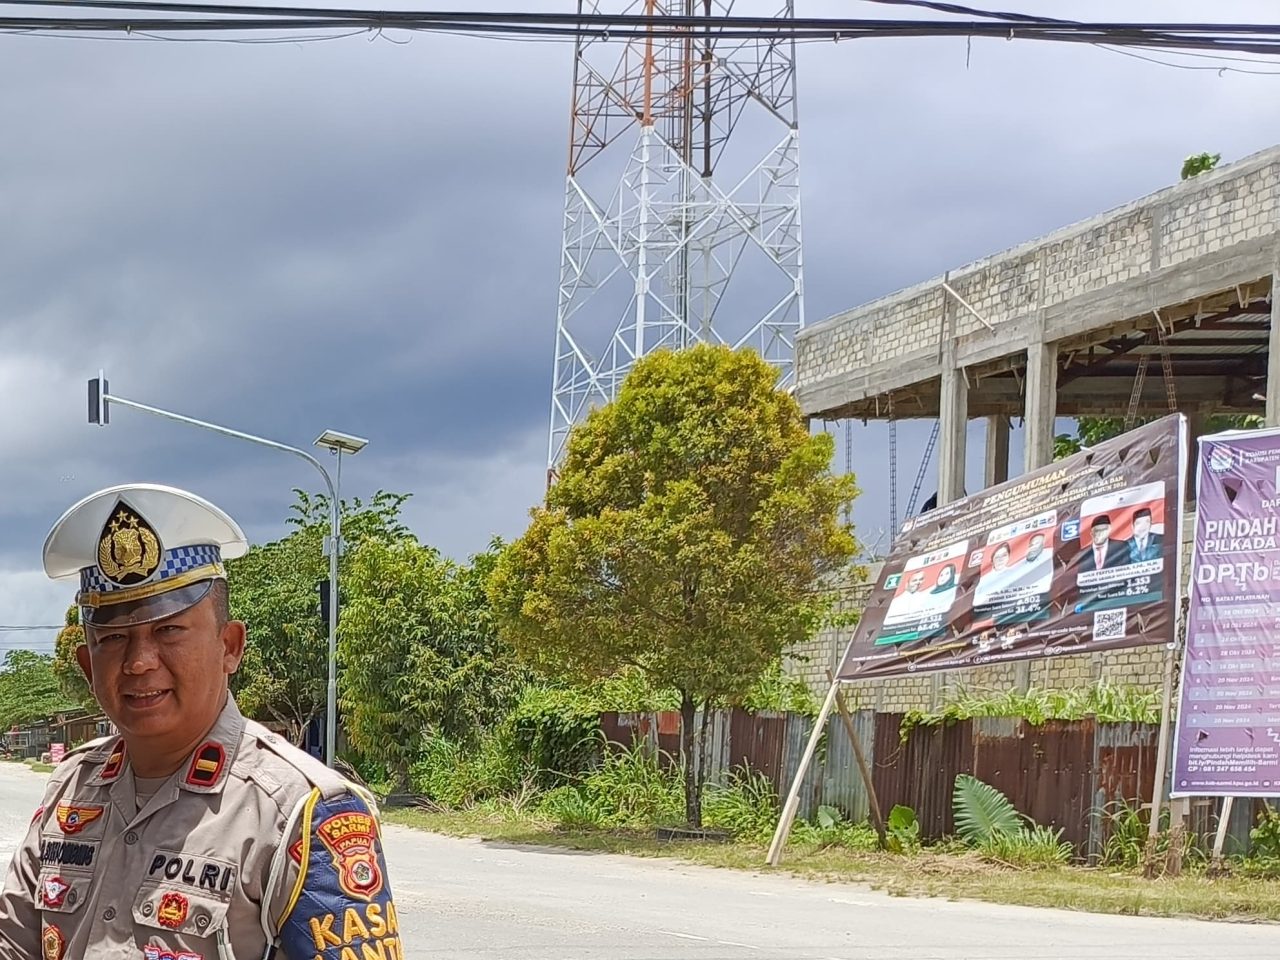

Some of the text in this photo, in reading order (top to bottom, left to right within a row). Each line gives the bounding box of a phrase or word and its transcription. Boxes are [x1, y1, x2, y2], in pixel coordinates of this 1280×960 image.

[982, 468, 1068, 508] PENGUMUMAN
[1065, 525, 1078, 538] 3
[1205, 516, 1277, 539] PINDAH
[1204, 537, 1276, 552] PILKADA
[1197, 561, 1269, 585] DPTb
[322, 815, 371, 833] POLRES
[331, 823, 370, 839] SARMI
[339, 838, 369, 851] PAPUA
[149, 854, 232, 891] POLRI
